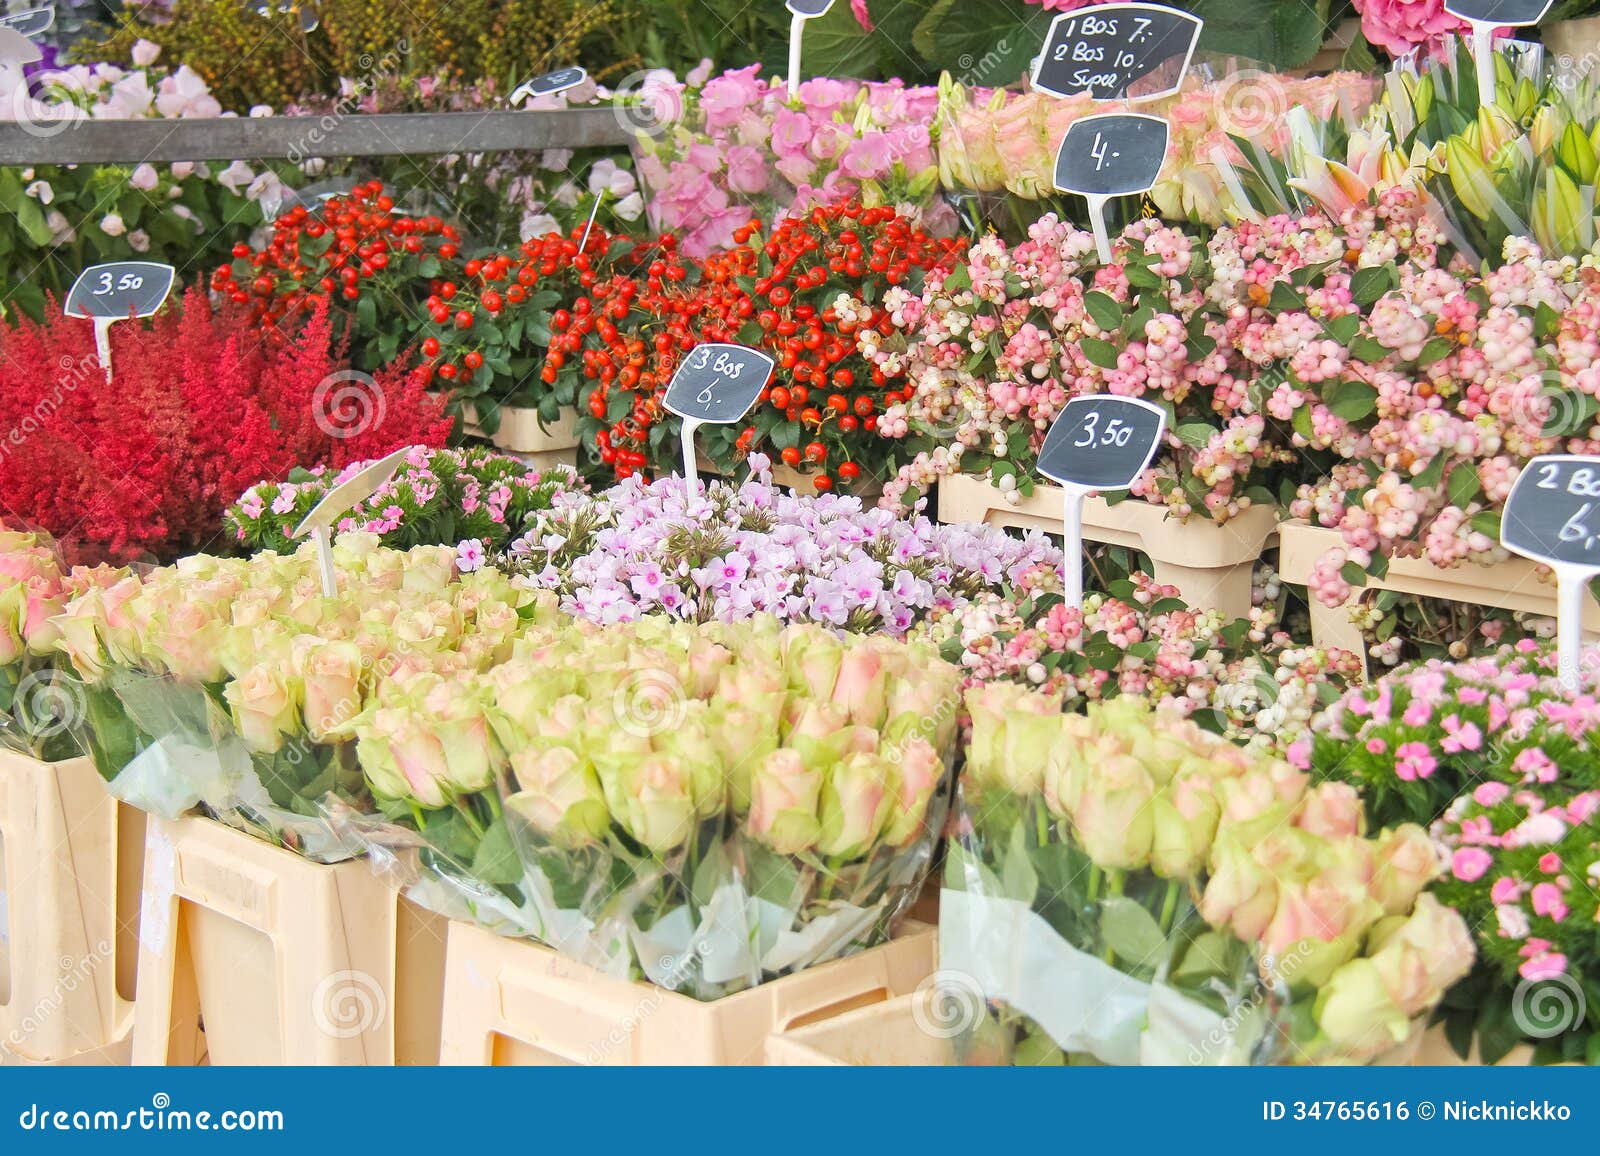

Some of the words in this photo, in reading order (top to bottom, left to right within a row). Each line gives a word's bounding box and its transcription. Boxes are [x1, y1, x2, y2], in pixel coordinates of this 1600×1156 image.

[1066, 19, 1076, 38] 1
[1053, 43, 1068, 61] 2
[693, 347, 711, 370] 3
[1536, 462, 1560, 489] 2
[1567, 467, 1600, 497] Bo
